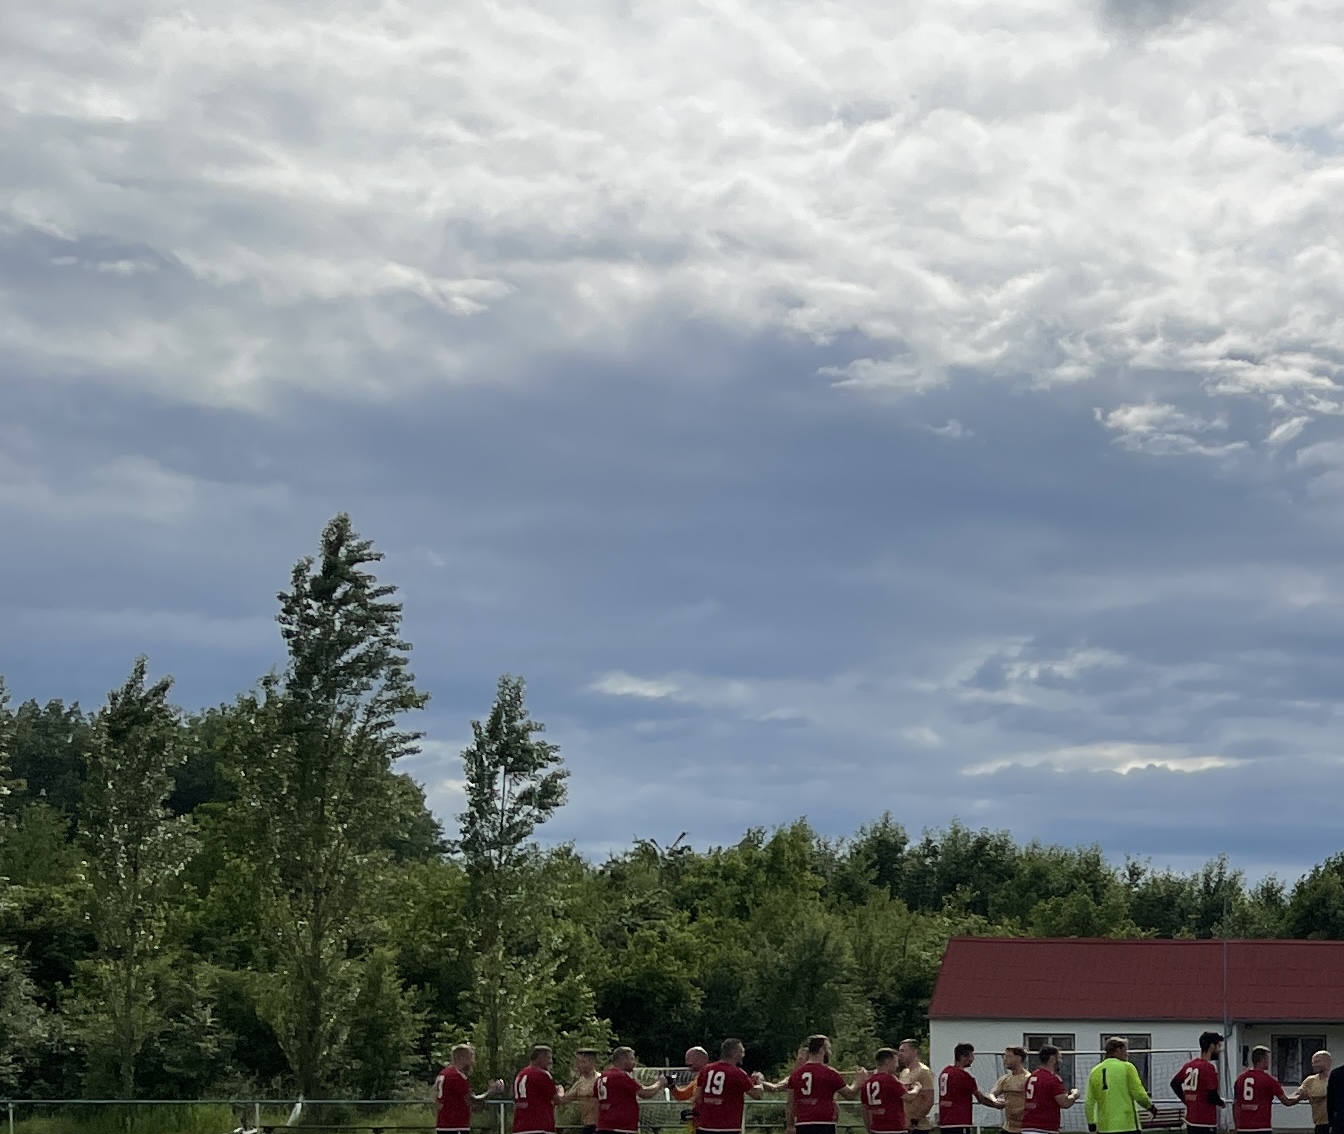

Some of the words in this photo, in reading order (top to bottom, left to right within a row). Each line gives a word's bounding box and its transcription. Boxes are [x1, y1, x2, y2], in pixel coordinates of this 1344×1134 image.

[704, 1070, 726, 1095] 19
[801, 1072, 813, 1096] 3
[1026, 1077, 1038, 1100] 5
[1102, 1068, 1109, 1091] 1
[1181, 1067, 1200, 1091] 20
[1243, 1077, 1255, 1101] 6
[866, 1081, 882, 1106] 12
